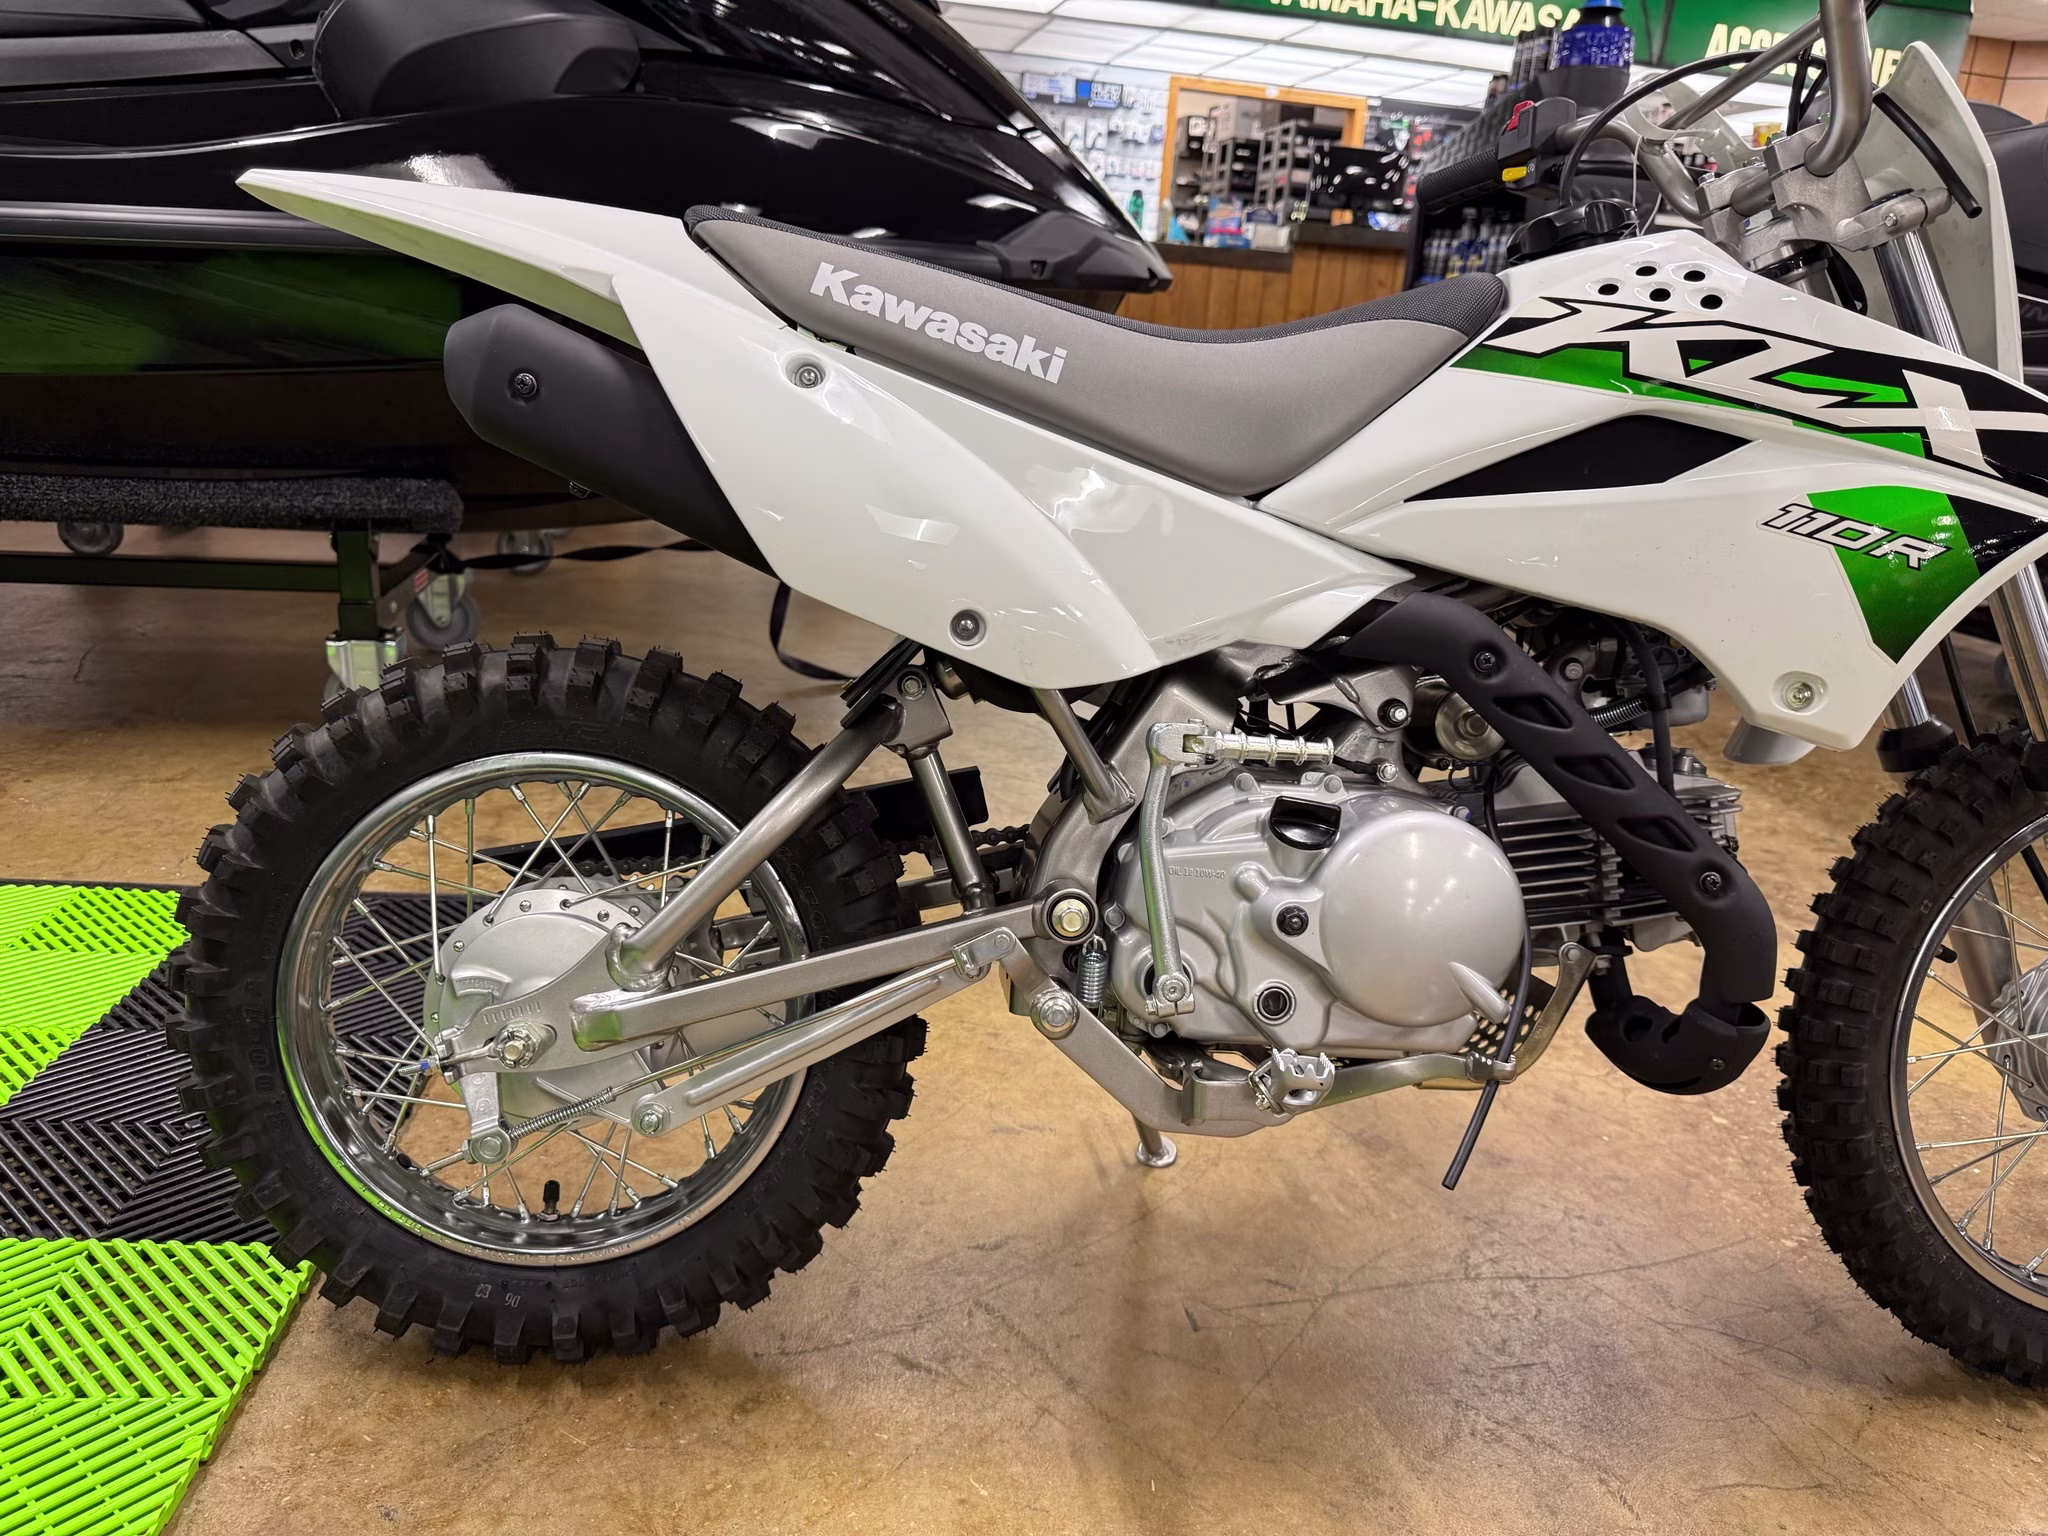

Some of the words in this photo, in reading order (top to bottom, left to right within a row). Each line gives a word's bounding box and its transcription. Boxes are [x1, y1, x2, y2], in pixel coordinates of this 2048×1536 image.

[810, 262, 1067, 384] Kawasaki
[1762, 503, 1953, 571] 110R
[1168, 866, 1181, 876] OIL
